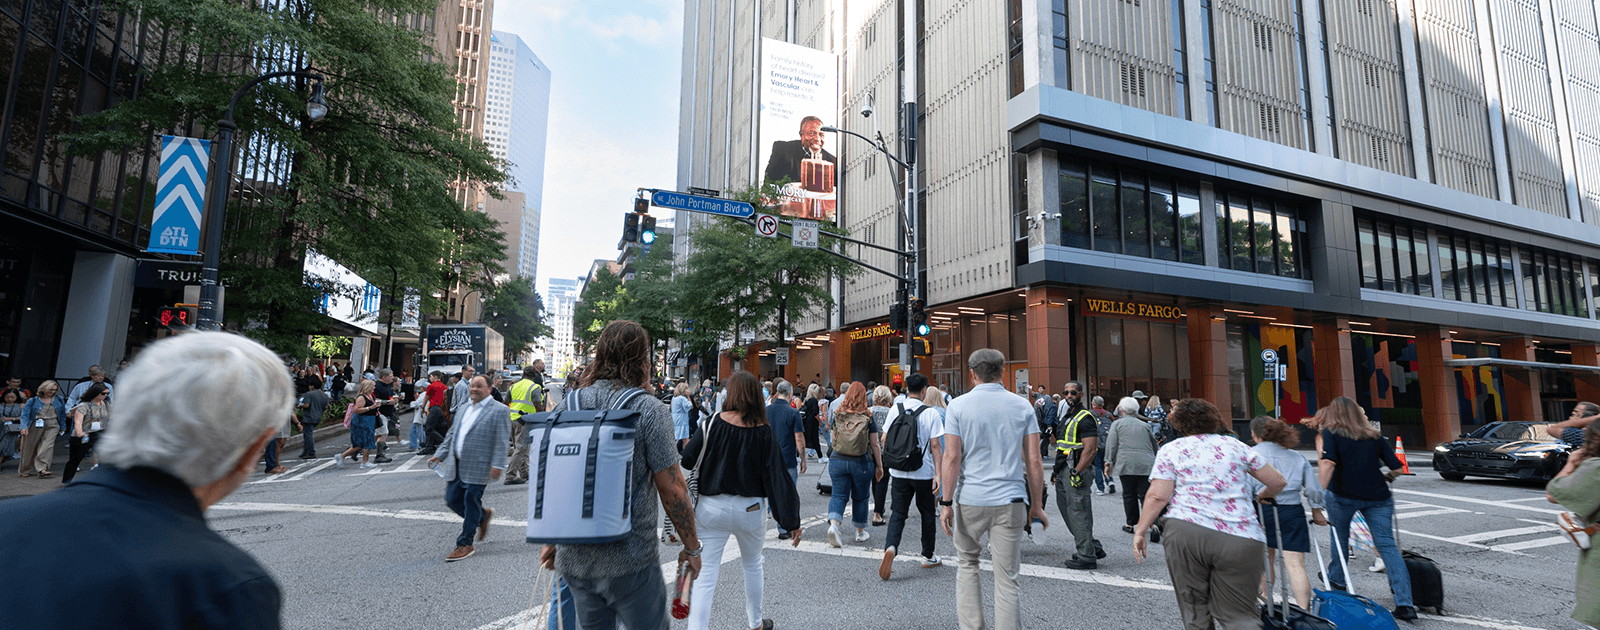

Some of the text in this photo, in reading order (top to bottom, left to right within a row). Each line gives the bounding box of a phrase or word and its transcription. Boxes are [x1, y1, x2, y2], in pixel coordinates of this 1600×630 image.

[770, 54, 814, 70] Family history
[779, 64, 798, 73] heart
[770, 70, 793, 82] Emory
[794, 76, 814, 85] Heart
[770, 78, 800, 90] Vascular
[770, 86, 786, 96] help
[786, 91, 808, 100] rewrite
[666, 194, 685, 206] John
[688, 198, 722, 211] Portman
[724, 202, 741, 214] Blvd
[160, 226, 188, 237] ATL
[160, 236, 188, 247] DTN
[1086, 298, 1182, 318] WELLS FARGO
[440, 334, 471, 346] ELYSIAN
[850, 328, 872, 340] WELLS
[557, 446, 579, 454] YETI
